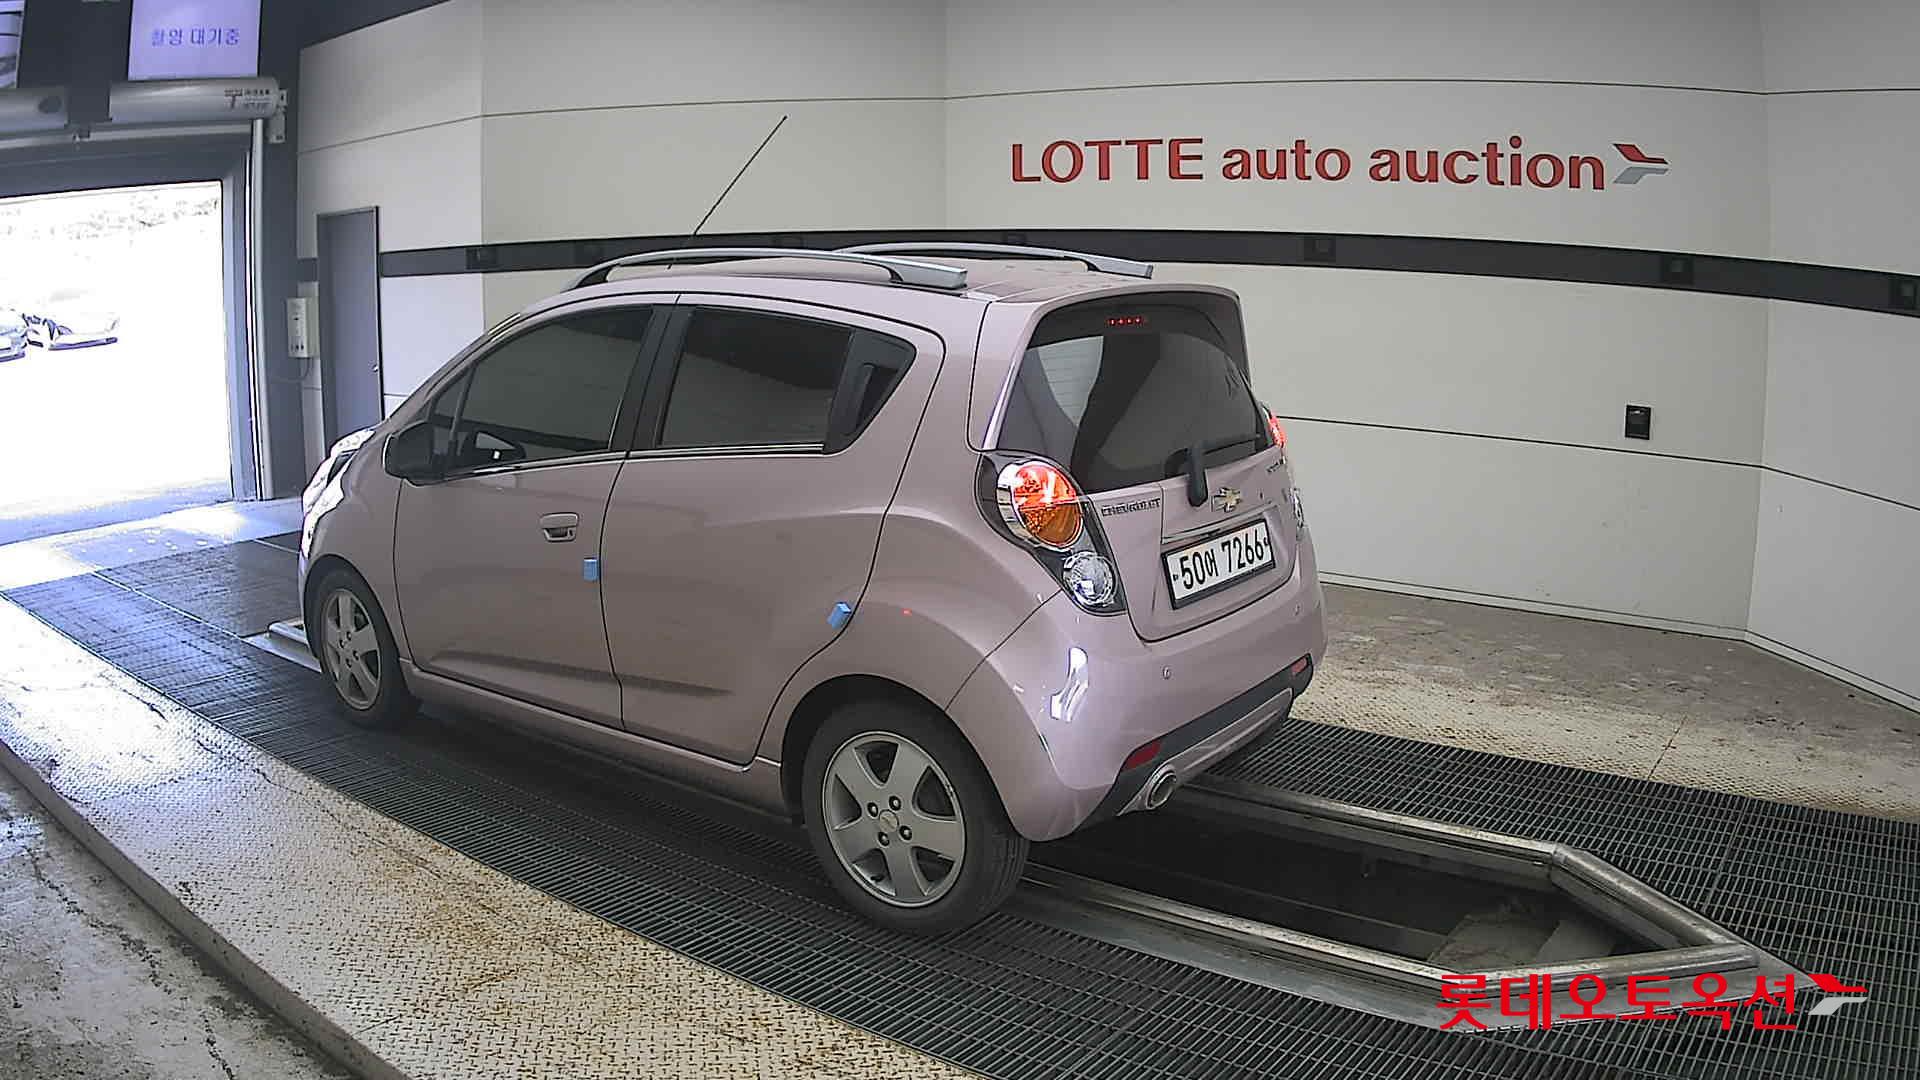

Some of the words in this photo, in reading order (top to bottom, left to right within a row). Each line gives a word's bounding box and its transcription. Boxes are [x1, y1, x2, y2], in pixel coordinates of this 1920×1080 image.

[191, 27, 239, 46] 대기중
[1011, 138, 1203, 182] LOTTE
[1222, 140, 1351, 181] auto
[1369, 135, 1606, 190] auction
[1179, 548, 1218, 590] 50어
[1221, 529, 1264, 573] 7266
